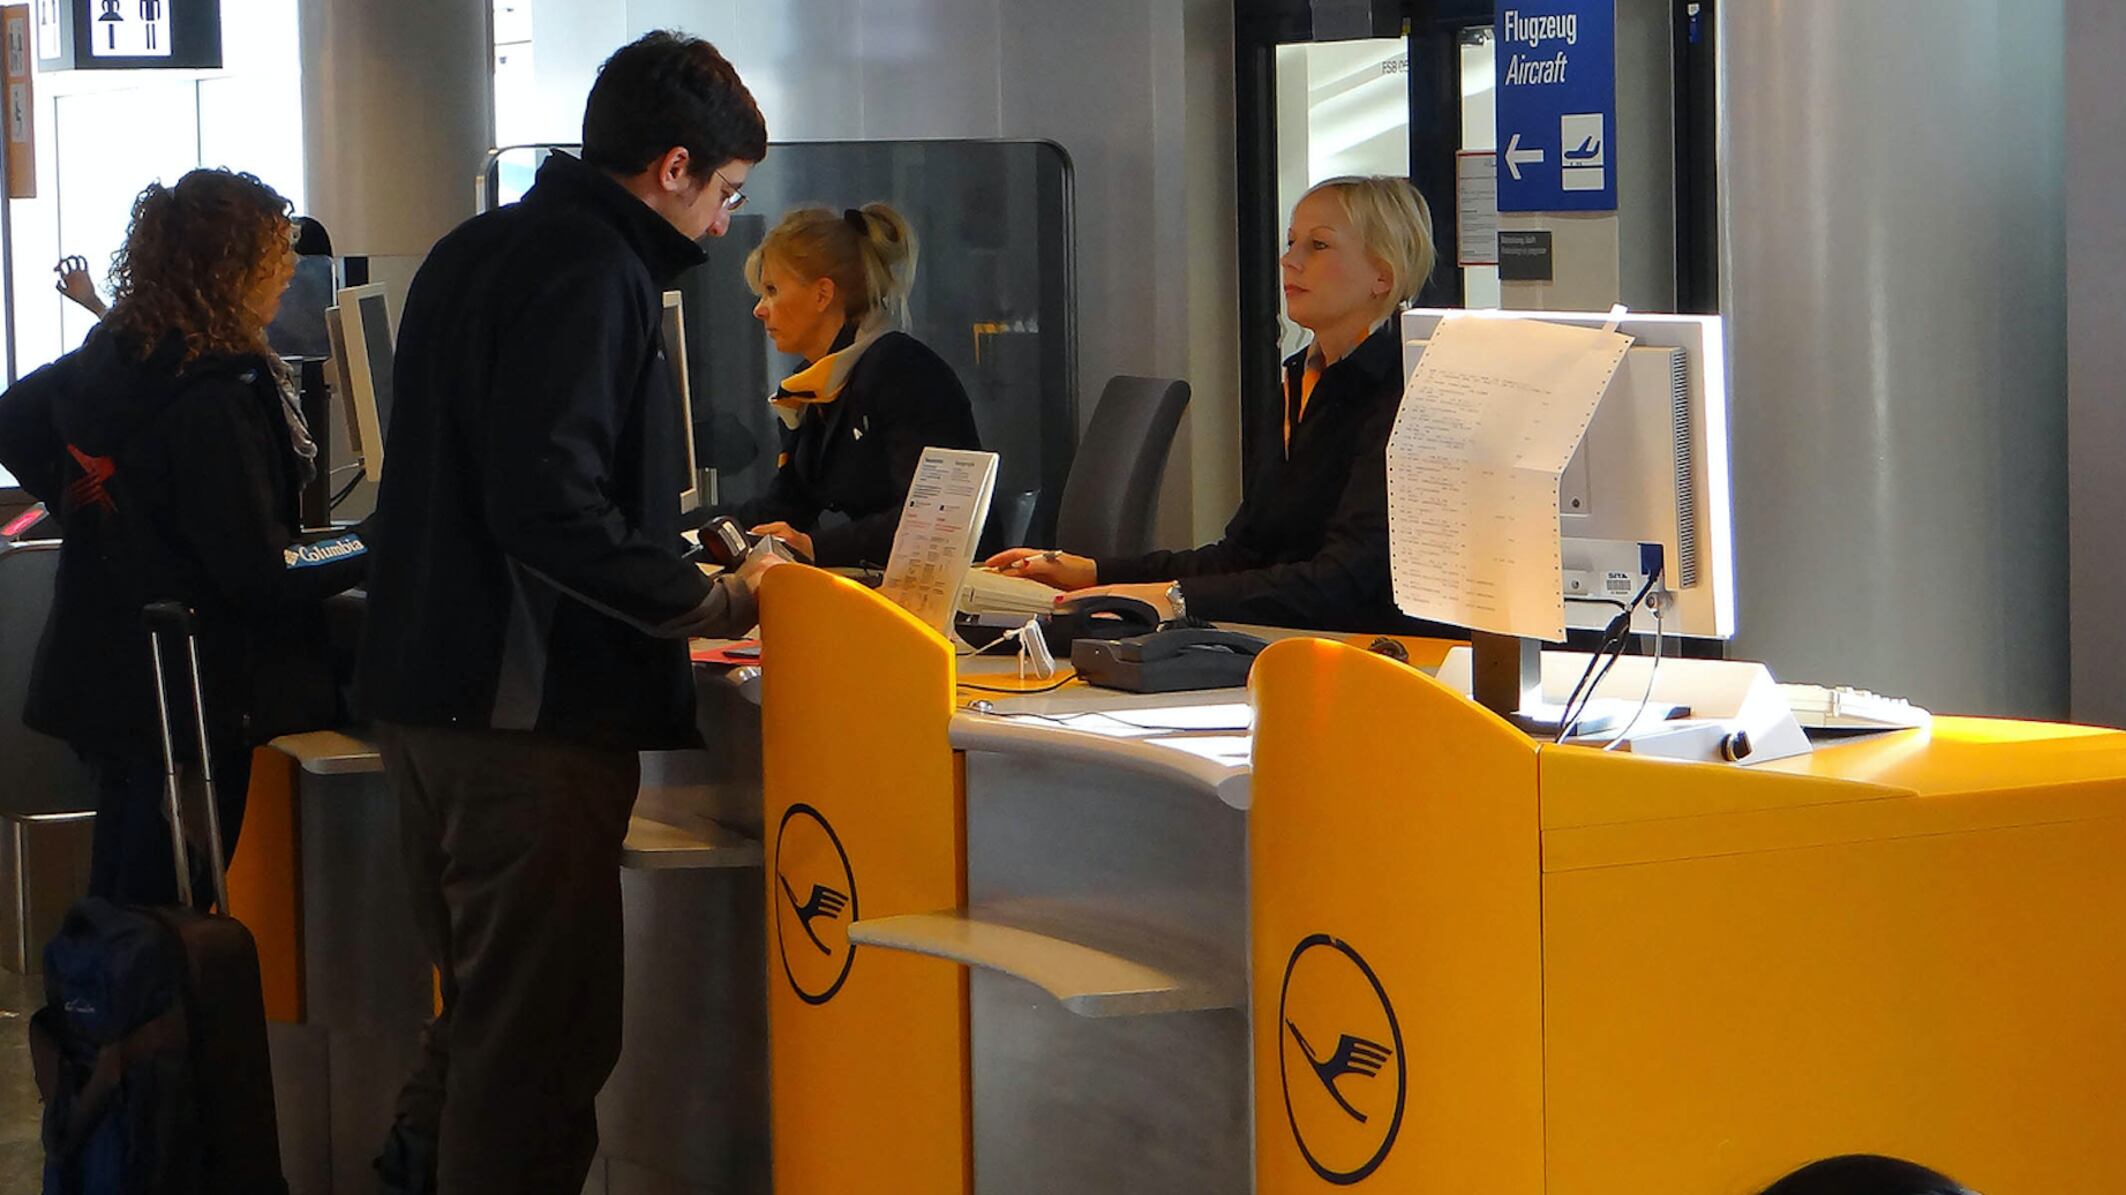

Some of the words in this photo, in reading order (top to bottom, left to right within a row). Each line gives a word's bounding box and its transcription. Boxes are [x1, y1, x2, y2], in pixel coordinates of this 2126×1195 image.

[1505, 10, 1577, 47] Flugzeug
[1505, 51, 1568, 85] Aircraft
[299, 538, 364, 562] Columbia
